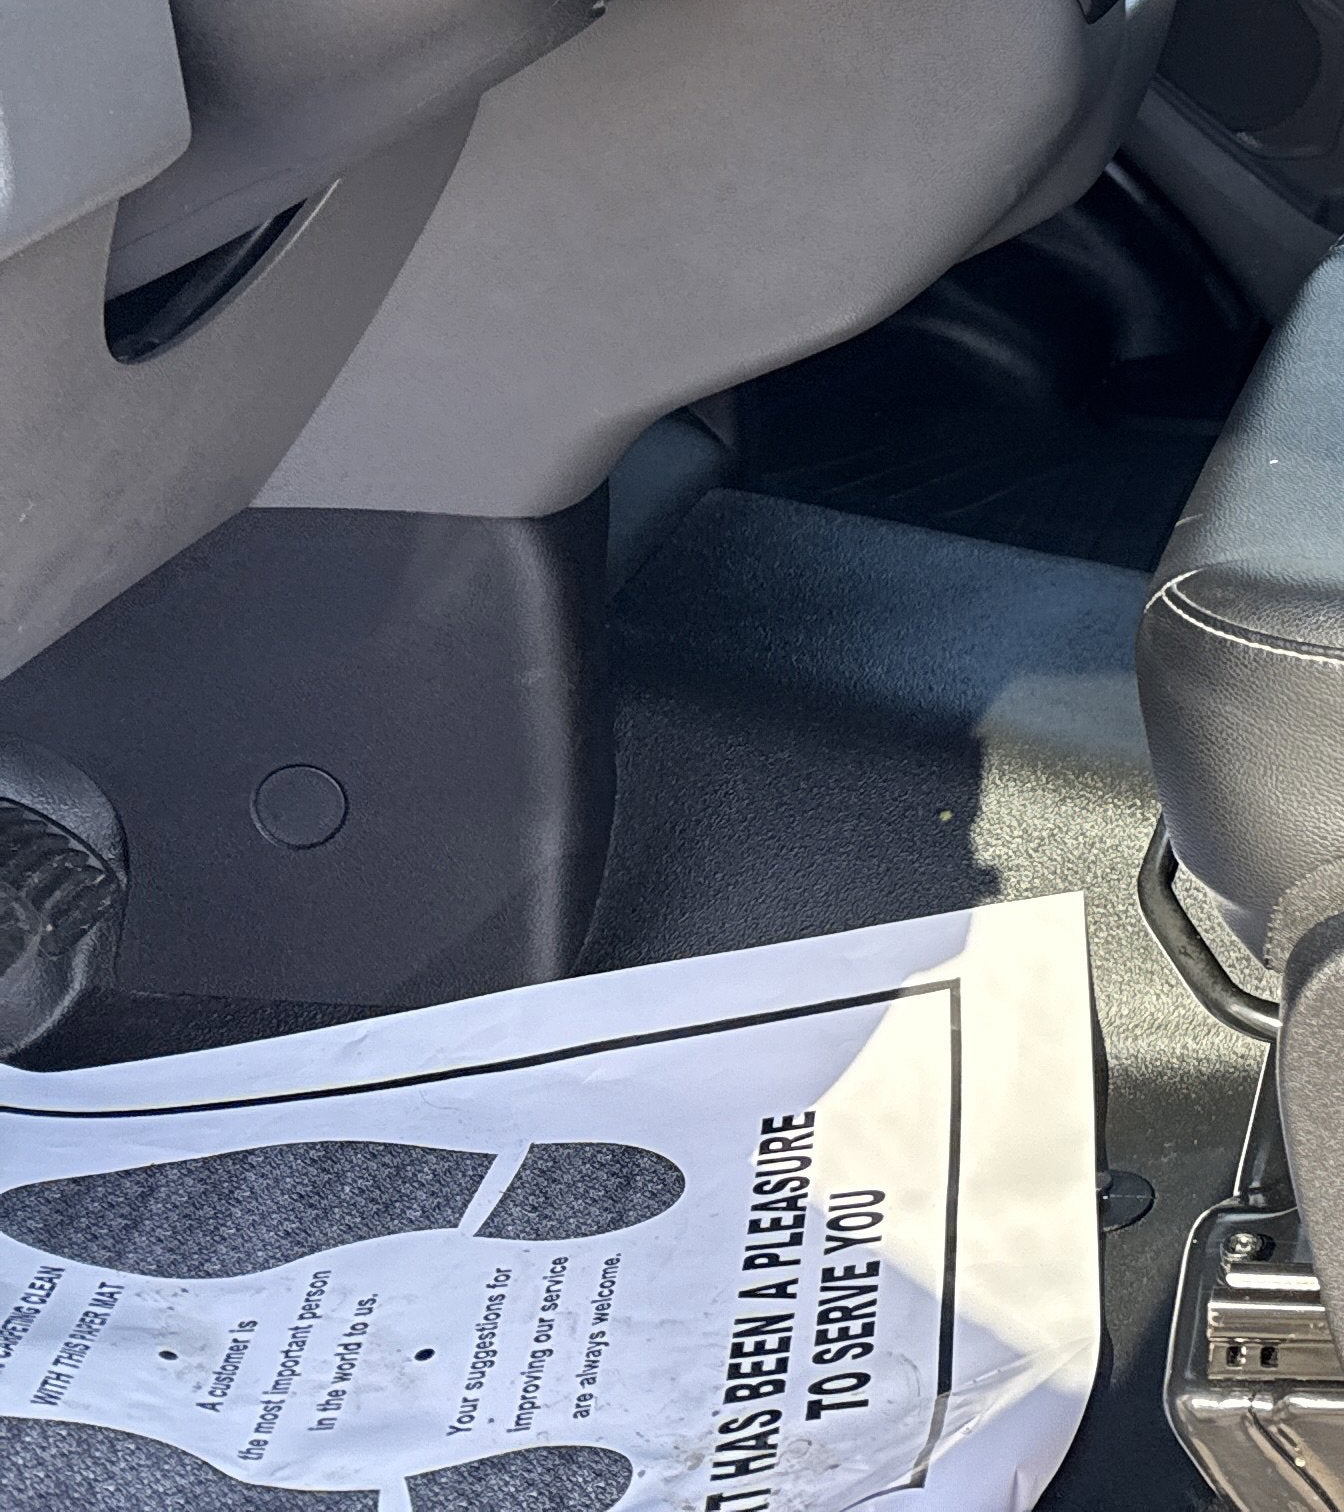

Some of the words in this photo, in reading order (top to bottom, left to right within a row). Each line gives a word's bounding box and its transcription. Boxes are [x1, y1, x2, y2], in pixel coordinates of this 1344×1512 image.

[742, 1110, 816, 1271] PLEASURE
[824, 1189, 886, 1256] YOU
[20, 1265, 66, 1304] CLEAN
[88, 1281, 125, 1309] MAT
[298, 1269, 332, 1323] person
[541, 1255, 569, 1312] service
[591, 1252, 622, 1326] welcome.
[738, 1278, 799, 1299] A
[350, 1293, 379, 1317] us.
[812, 1260, 881, 1365] SERVE
[68, 1310, 111, 1342] PAPER
[343, 1322, 370, 1341] to
[534, 1317, 556, 1343] our
[52, 1341, 91, 1369] THIS
[208, 1337, 251, 1399] customer
[263, 1324, 314, 1396] important
[333, 1342, 363, 1385] world
[446, 1396, 480, 1436] Your
[465, 1293, 506, 1391] suggestions
[486, 1267, 512, 1289] for
[575, 1330, 609, 1390] always
[723, 1312, 796, 1405] BEEN
[30, 1370, 74, 1406] WITH
[196, 1402, 223, 1413] A
[316, 1389, 348, 1413] the
[573, 1391, 594, 1419] are
[806, 1372, 871, 1421] TO
[254, 1396, 286, 1434] most
[238, 1439, 269, 1461] the
[709, 1409, 782, 1482] HAS
